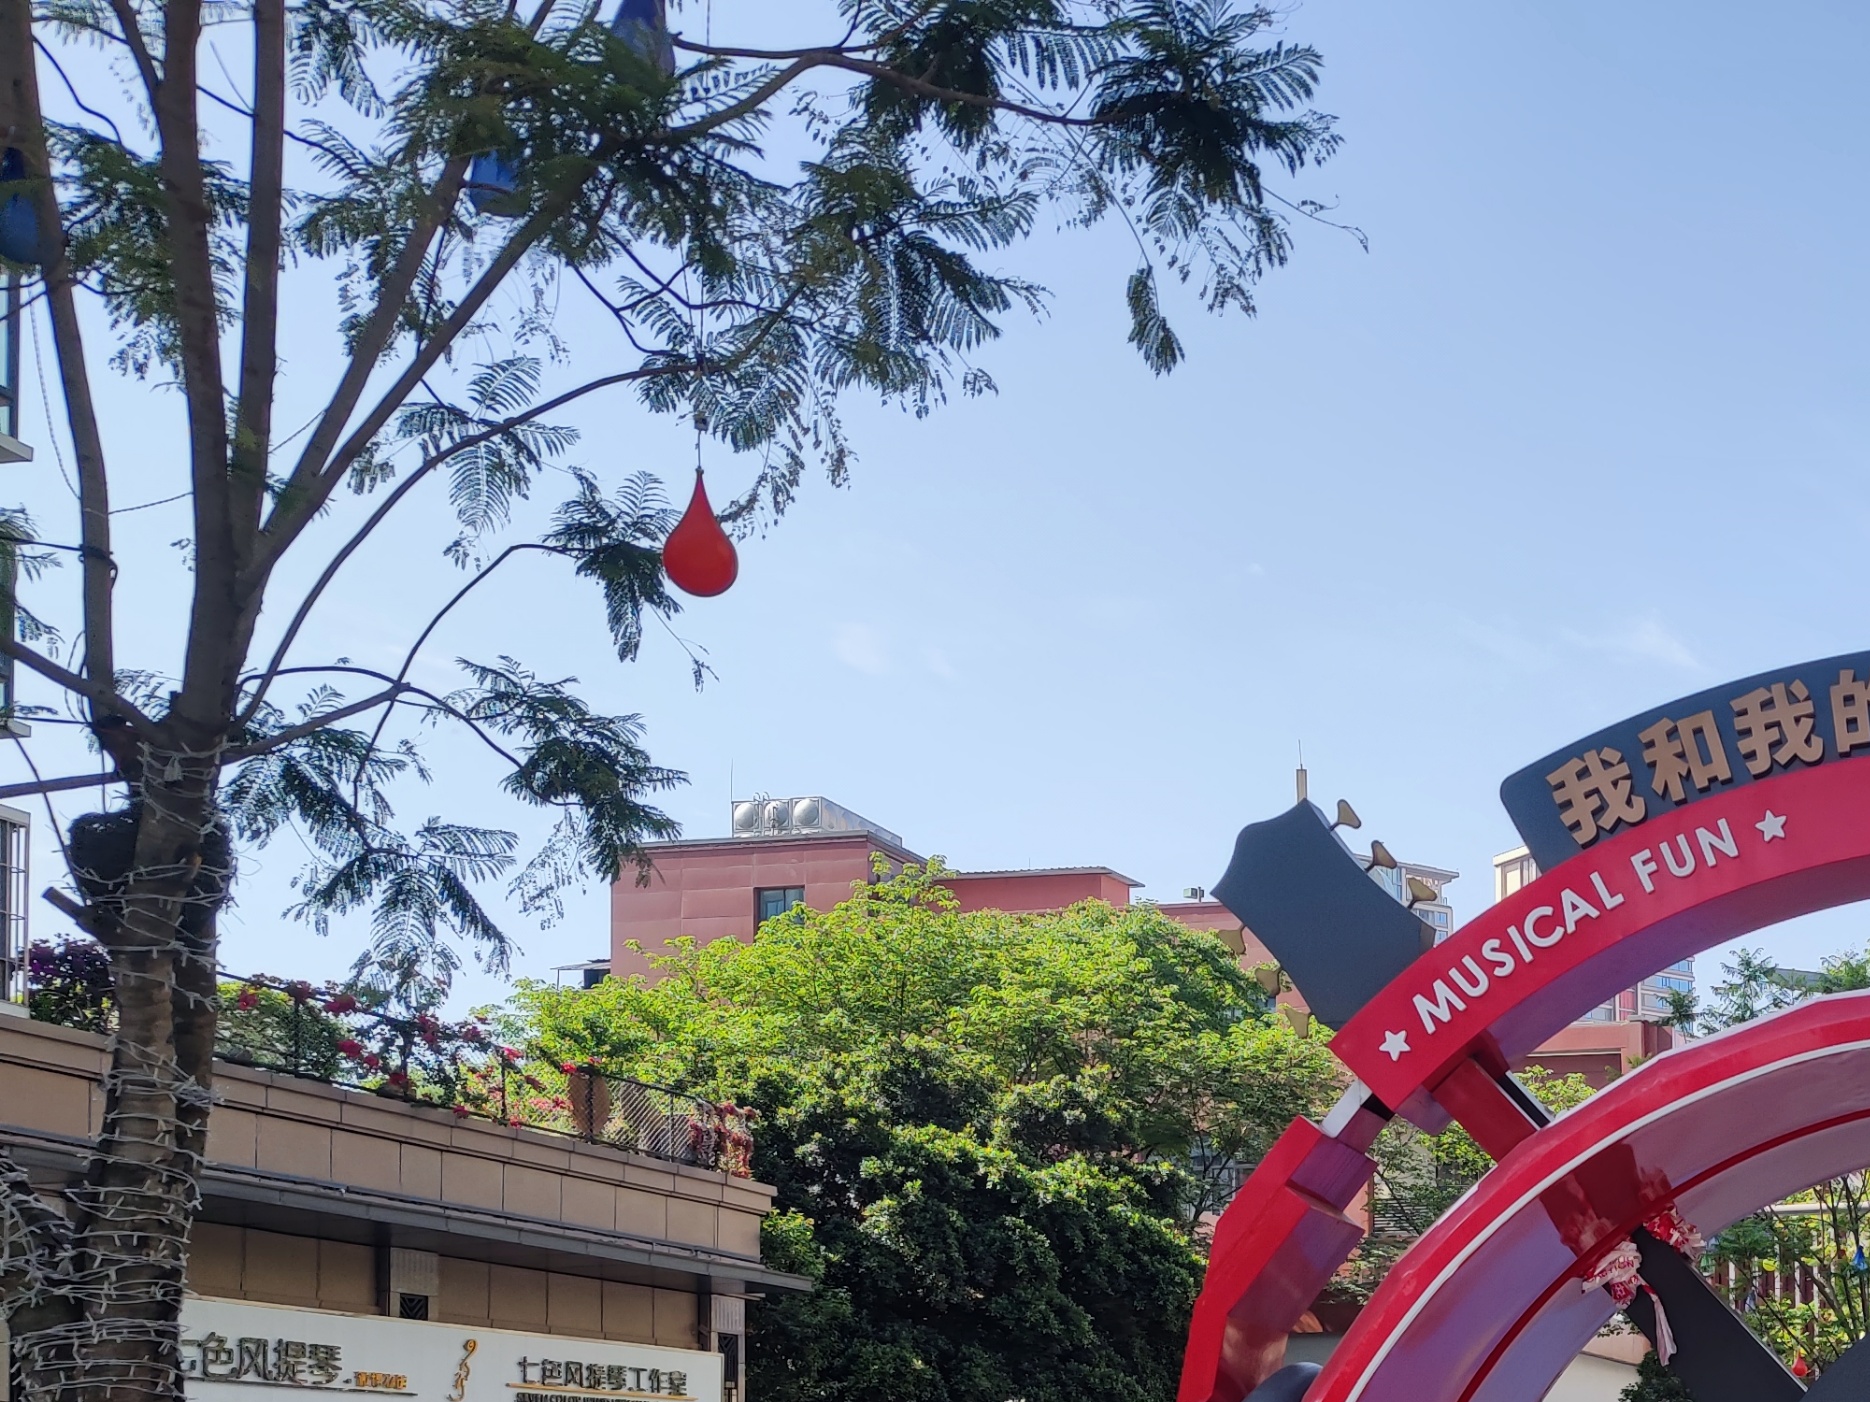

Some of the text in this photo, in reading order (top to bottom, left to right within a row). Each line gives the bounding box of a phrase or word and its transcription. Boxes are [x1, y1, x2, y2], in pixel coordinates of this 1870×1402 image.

[1412, 818, 1739, 1034] MUSICAL FUN
[516, 1356, 688, 1396] 七色风提琴工作室
